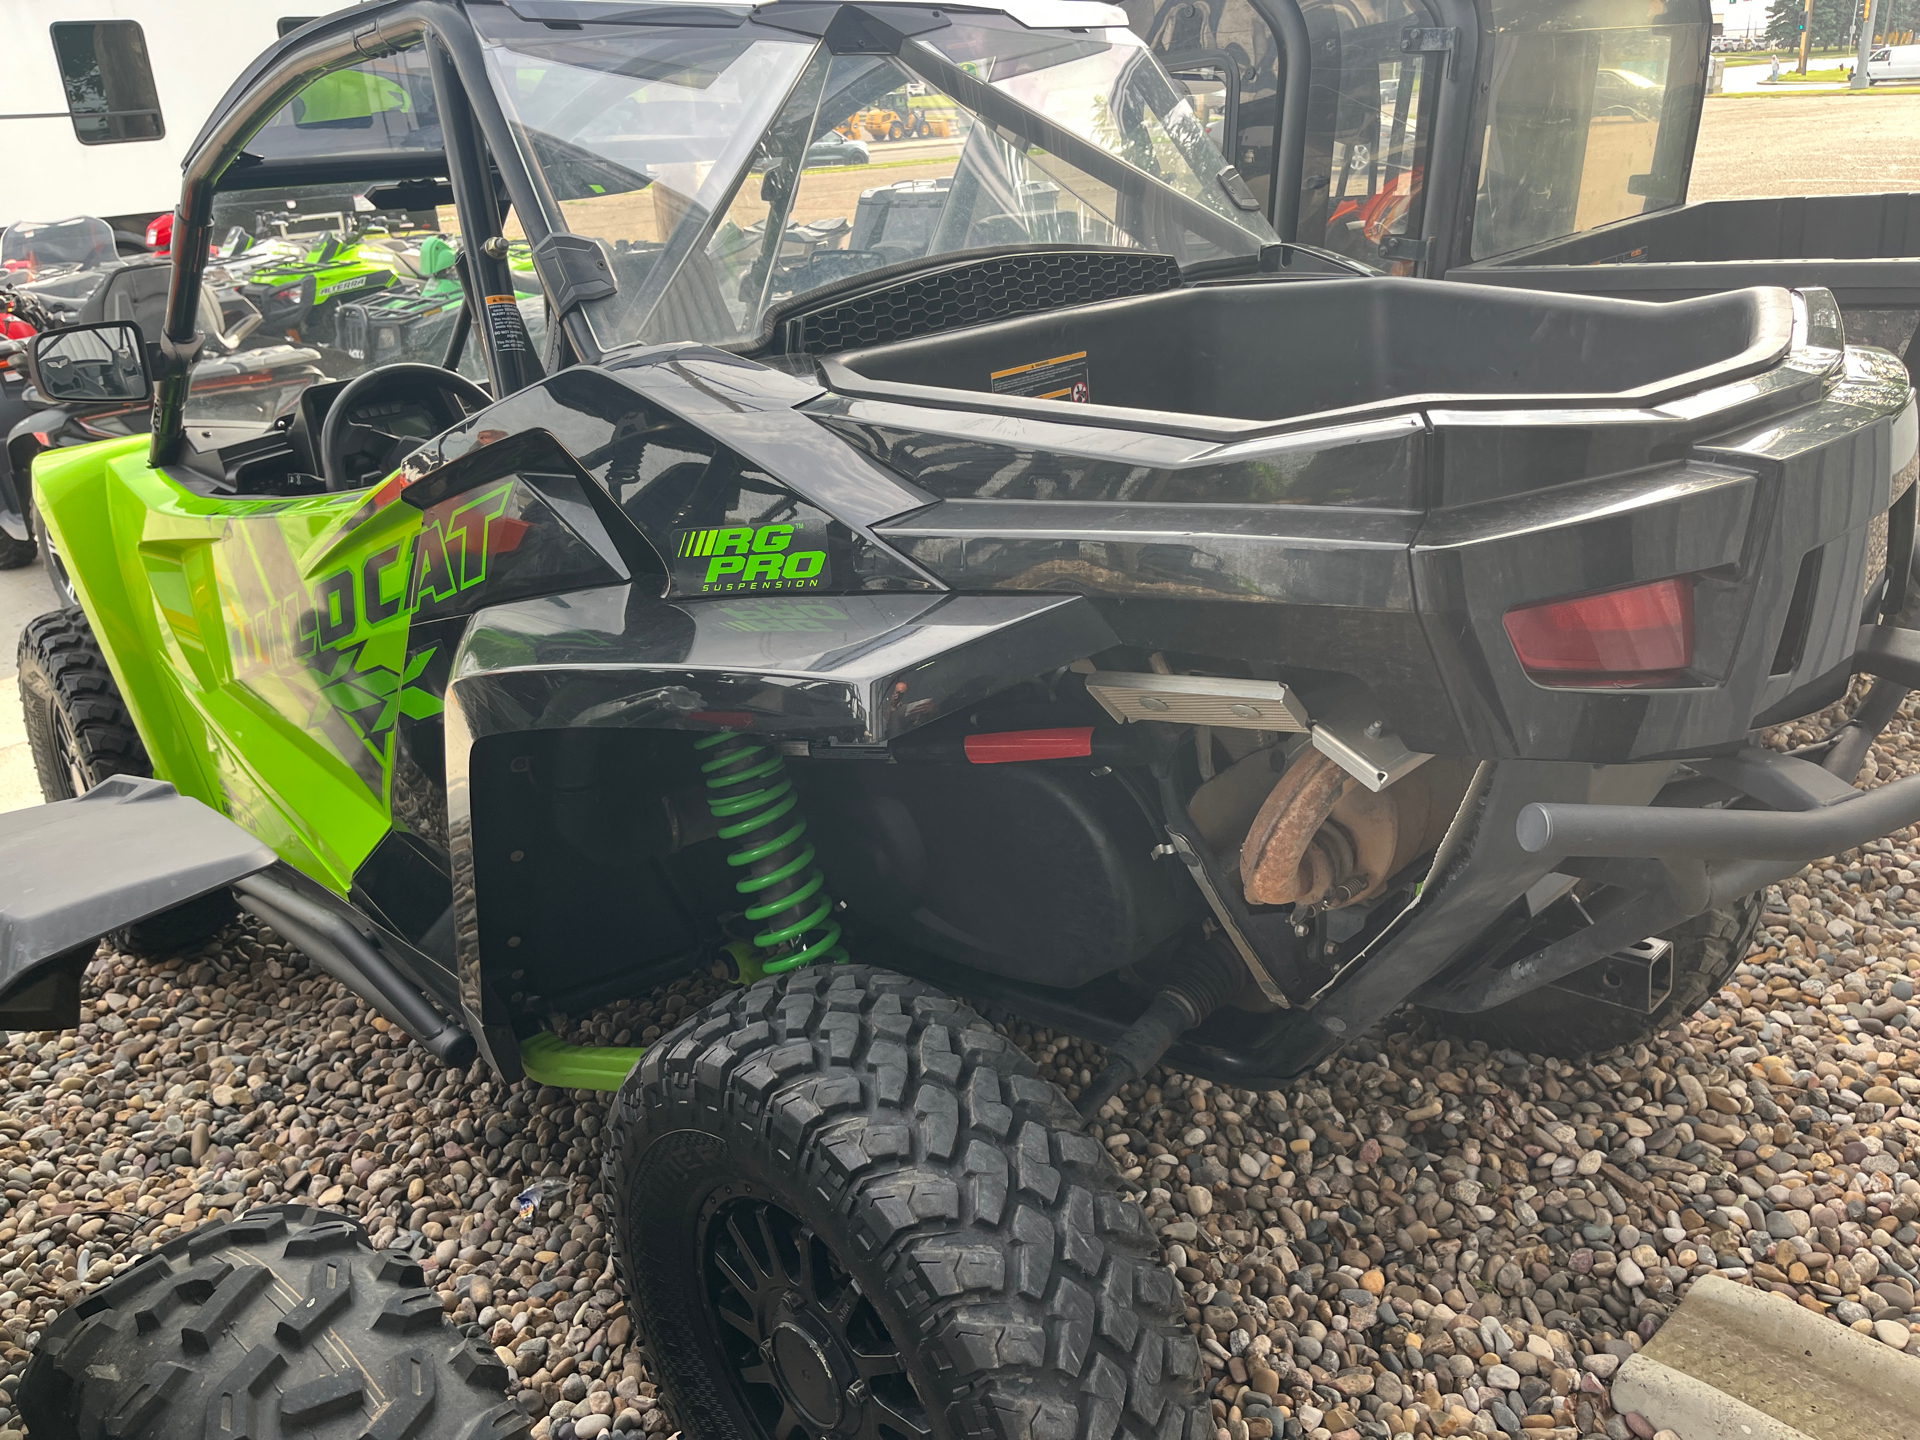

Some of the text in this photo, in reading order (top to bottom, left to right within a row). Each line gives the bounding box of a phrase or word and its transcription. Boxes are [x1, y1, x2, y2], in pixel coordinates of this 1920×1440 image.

[319, 277, 366, 296] ALTERRA
[704, 550, 827, 583] PRO
[701, 579, 818, 592] SUSPENSION
